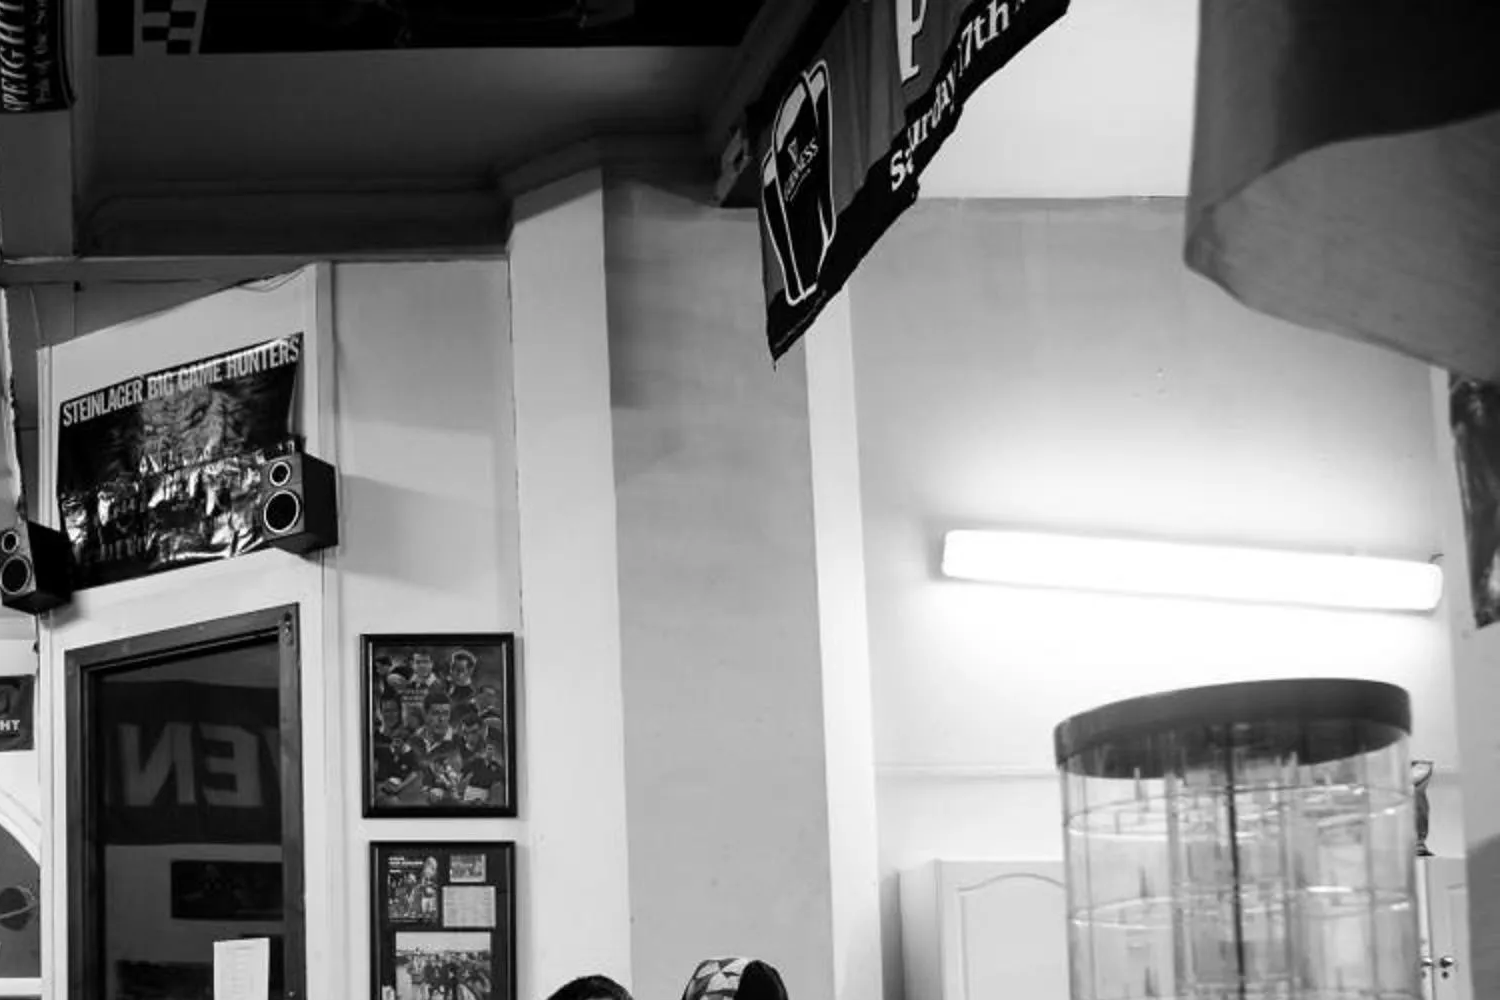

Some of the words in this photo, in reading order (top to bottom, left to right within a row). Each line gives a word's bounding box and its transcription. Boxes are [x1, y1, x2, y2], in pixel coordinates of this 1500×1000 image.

[890, 60, 957, 192] Surday
[63, 379, 143, 427] STEINLAGER
[147, 372, 175, 400] BIG
[177, 363, 223, 393] GAME
[226, 338, 299, 379] HUNTERS
